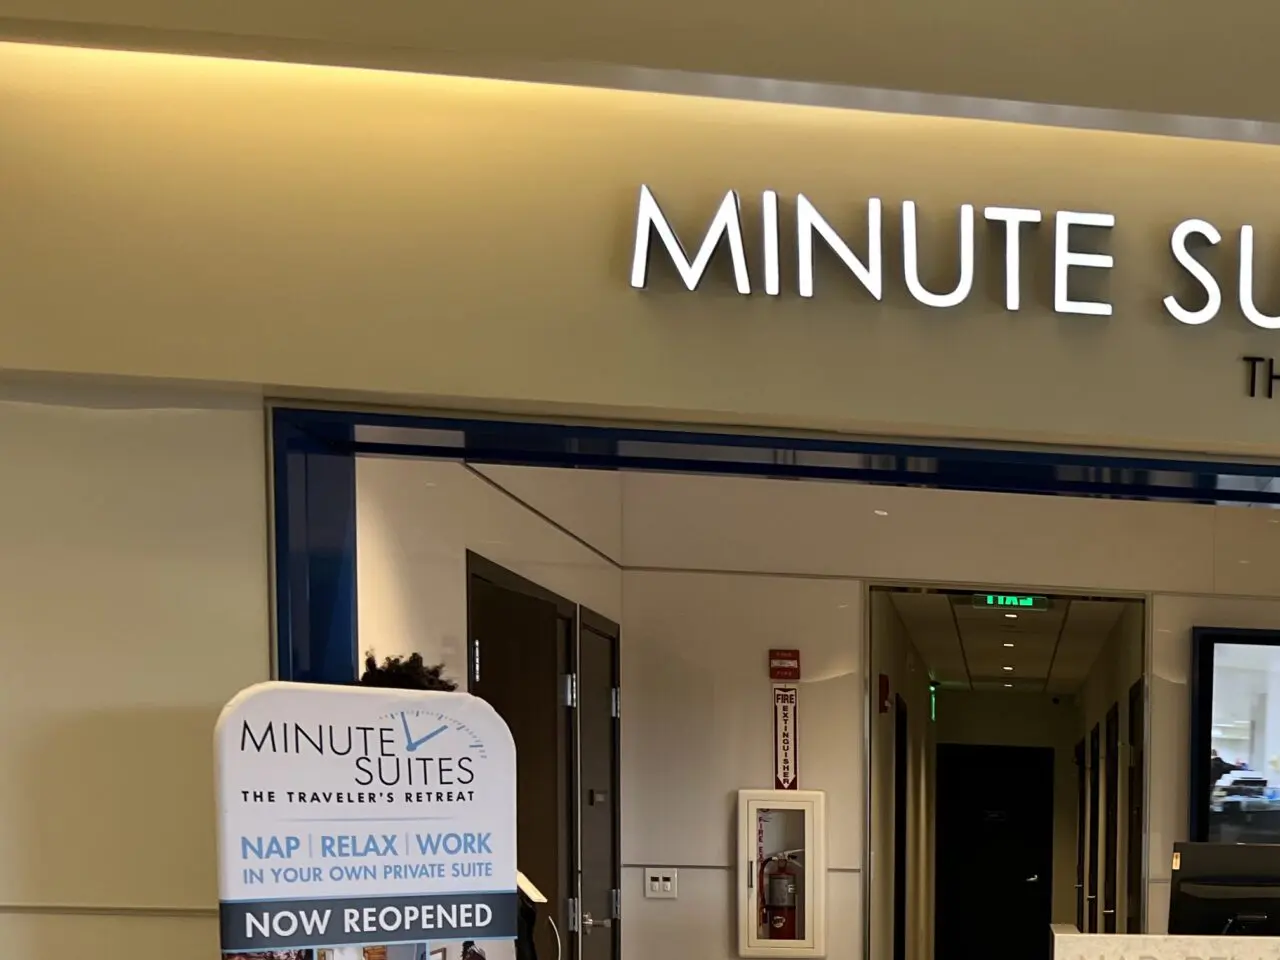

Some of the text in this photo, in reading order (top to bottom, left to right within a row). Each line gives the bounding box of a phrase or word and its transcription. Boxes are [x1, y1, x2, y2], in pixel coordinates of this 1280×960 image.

[630, 183, 1115, 316] MINUTE
[776, 693, 795, 704] FIRE
[240, 719, 396, 757] MINUTE
[782, 705, 790, 784] EXTINGUISHER
[354, 755, 475, 786] SUITES
[241, 790, 475, 804] THE TRAVELER'S RETREAT
[240, 832, 493, 860] NAP RELAX WORK
[243, 862, 493, 884] IN YOUR OWN PRIVATE SUITE
[245, 903, 493, 938] NOW REOPENED
